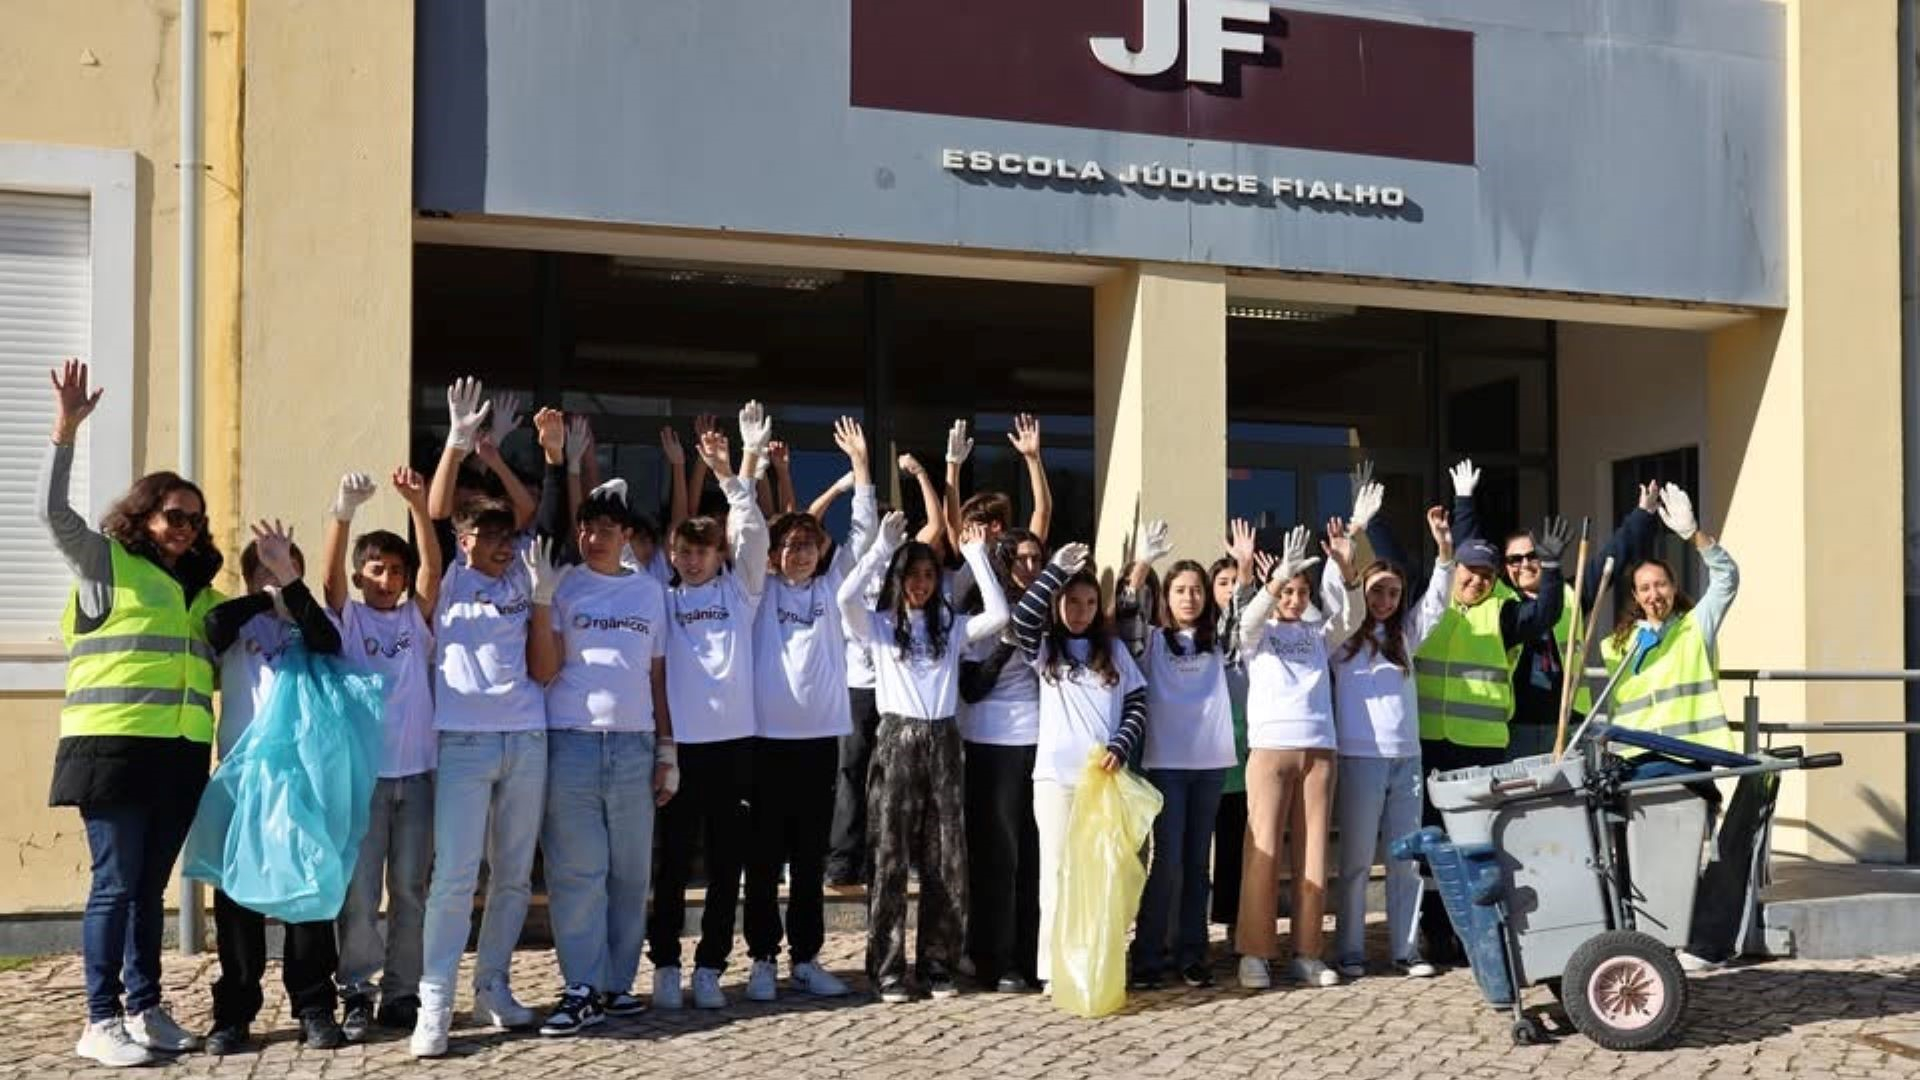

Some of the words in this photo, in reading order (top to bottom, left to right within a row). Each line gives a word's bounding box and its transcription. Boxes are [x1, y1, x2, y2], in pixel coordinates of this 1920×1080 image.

[1089, 0, 1270, 84] JF
[943, 149, 1104, 180] ESCOLA
[1119, 161, 1258, 194] JÚDICE
[1273, 176, 1404, 206] FIALHO
[573, 613, 650, 634] Orgânicos
